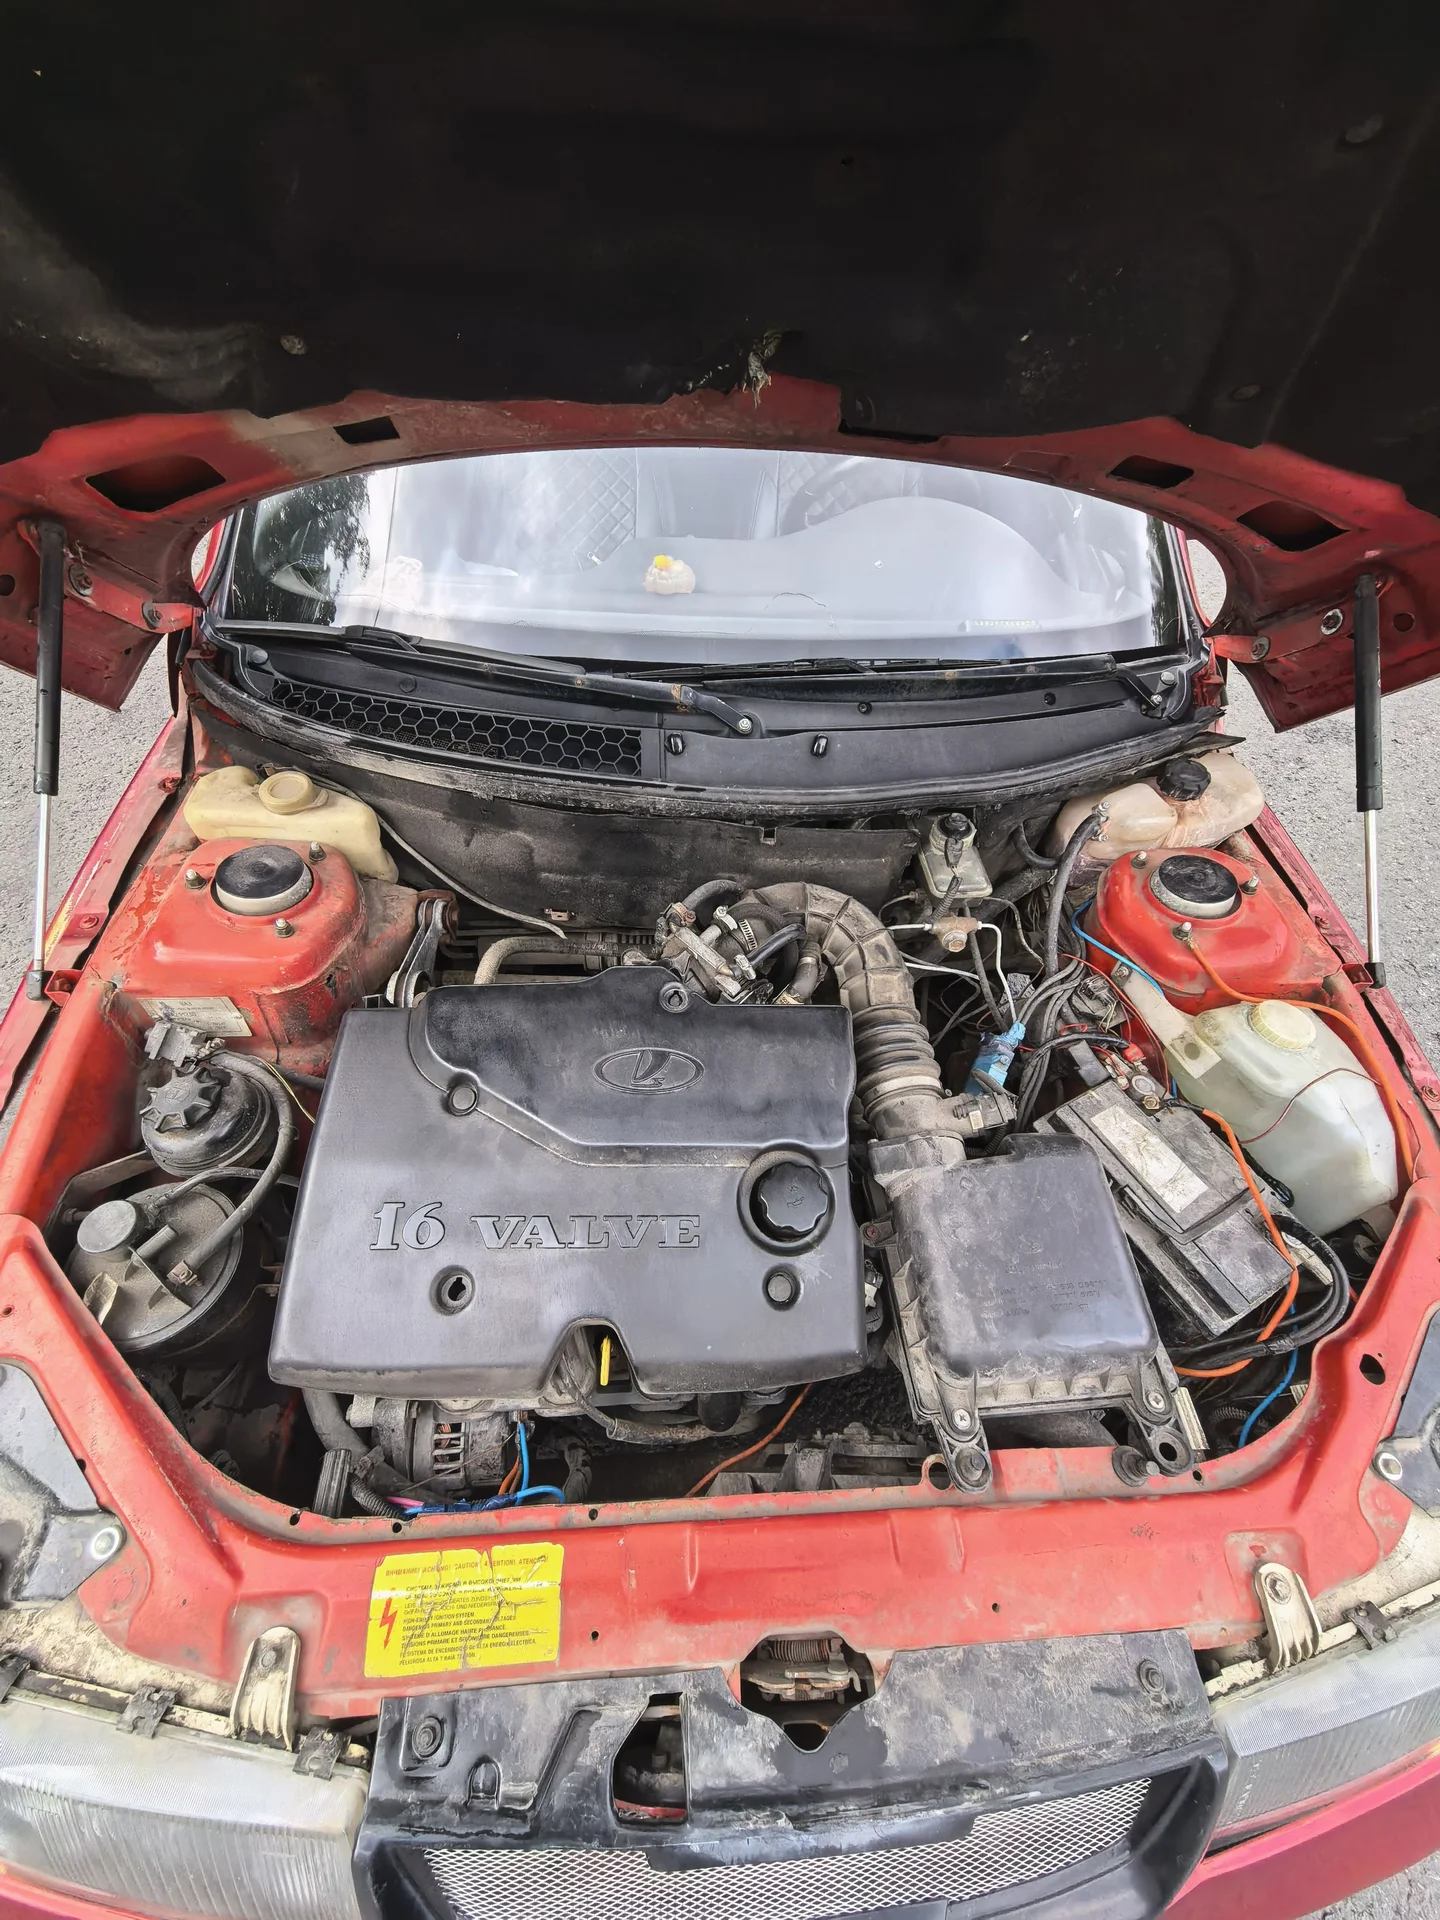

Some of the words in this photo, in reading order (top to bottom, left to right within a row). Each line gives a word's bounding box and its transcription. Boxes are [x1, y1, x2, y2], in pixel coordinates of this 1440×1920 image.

[369, 1201, 446, 1251] 16
[470, 1214, 701, 1250] VALVE
[484, 1559, 516, 1567] AENTION!
